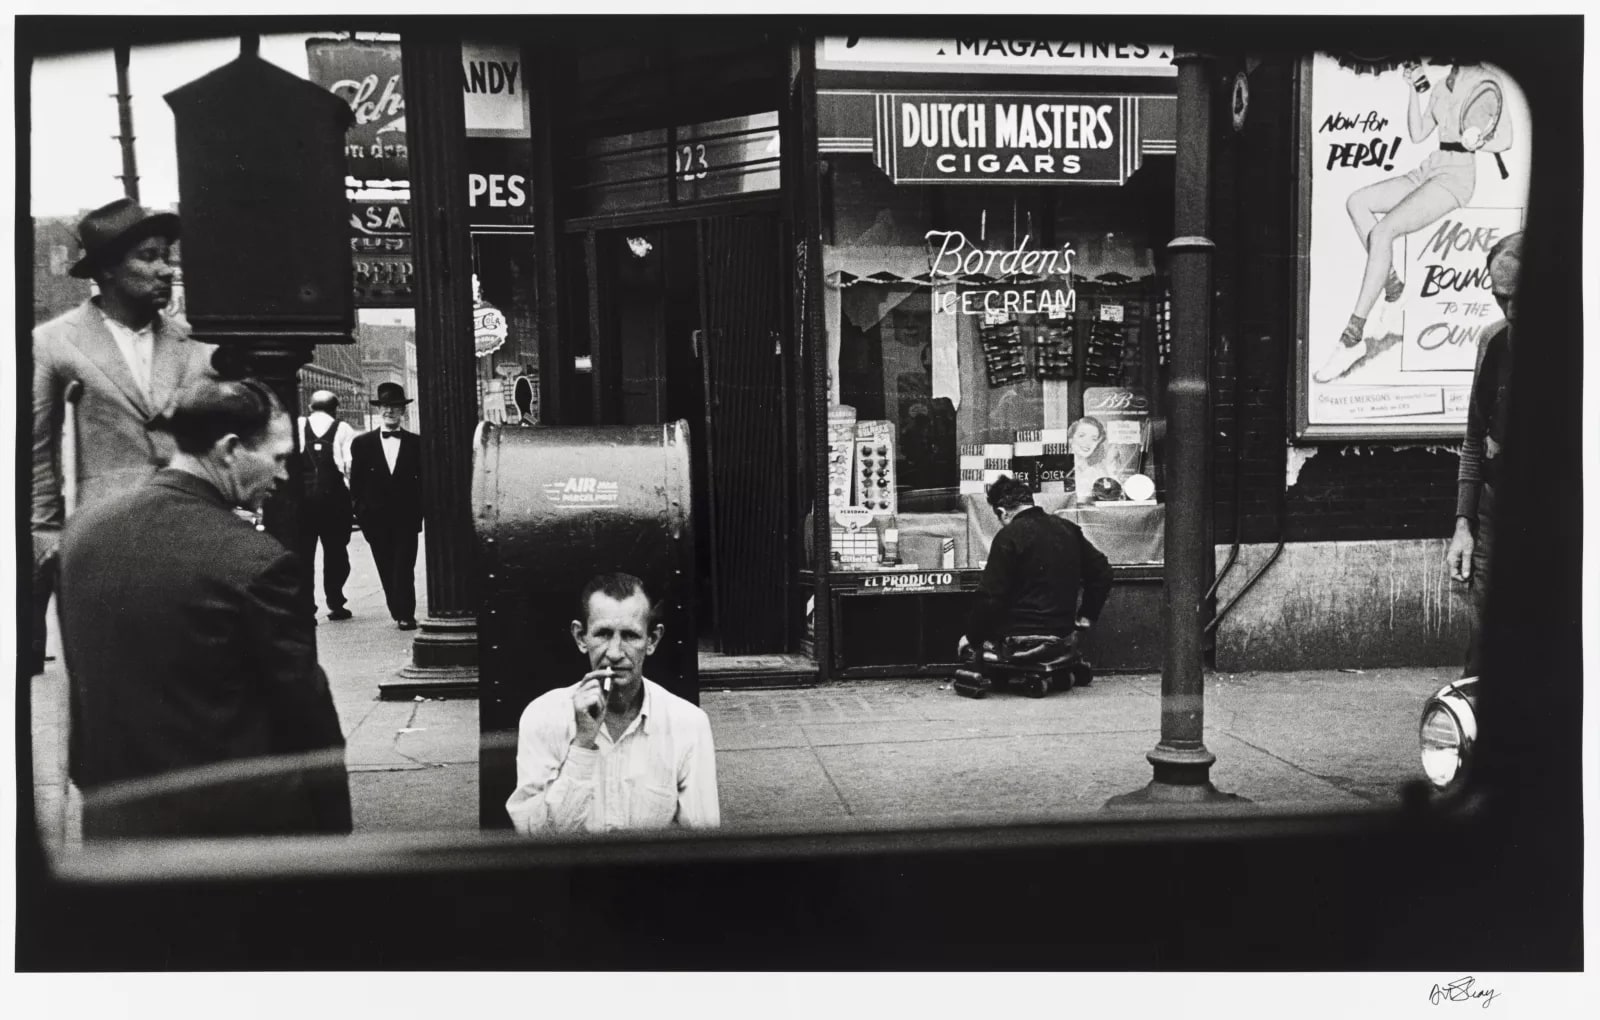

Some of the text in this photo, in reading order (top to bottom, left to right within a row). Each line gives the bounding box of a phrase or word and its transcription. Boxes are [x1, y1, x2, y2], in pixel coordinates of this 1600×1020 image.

[902, 103, 1114, 150] DUTCH MASTERS
[1318, 110, 1388, 133] Now for
[936, 154, 1081, 174] CIGARS
[1326, 136, 1403, 172] PEPSI!
[468, 173, 526, 207] PES
[924, 230, 1076, 277] Borden's
[1416, 219, 1500, 262] MORE
[934, 291, 977, 315] ICE
[984, 289, 1076, 314] CREAM
[1436, 301, 1491, 317] TO THE
[864, 573, 952, 587] EL PRODUCTO
